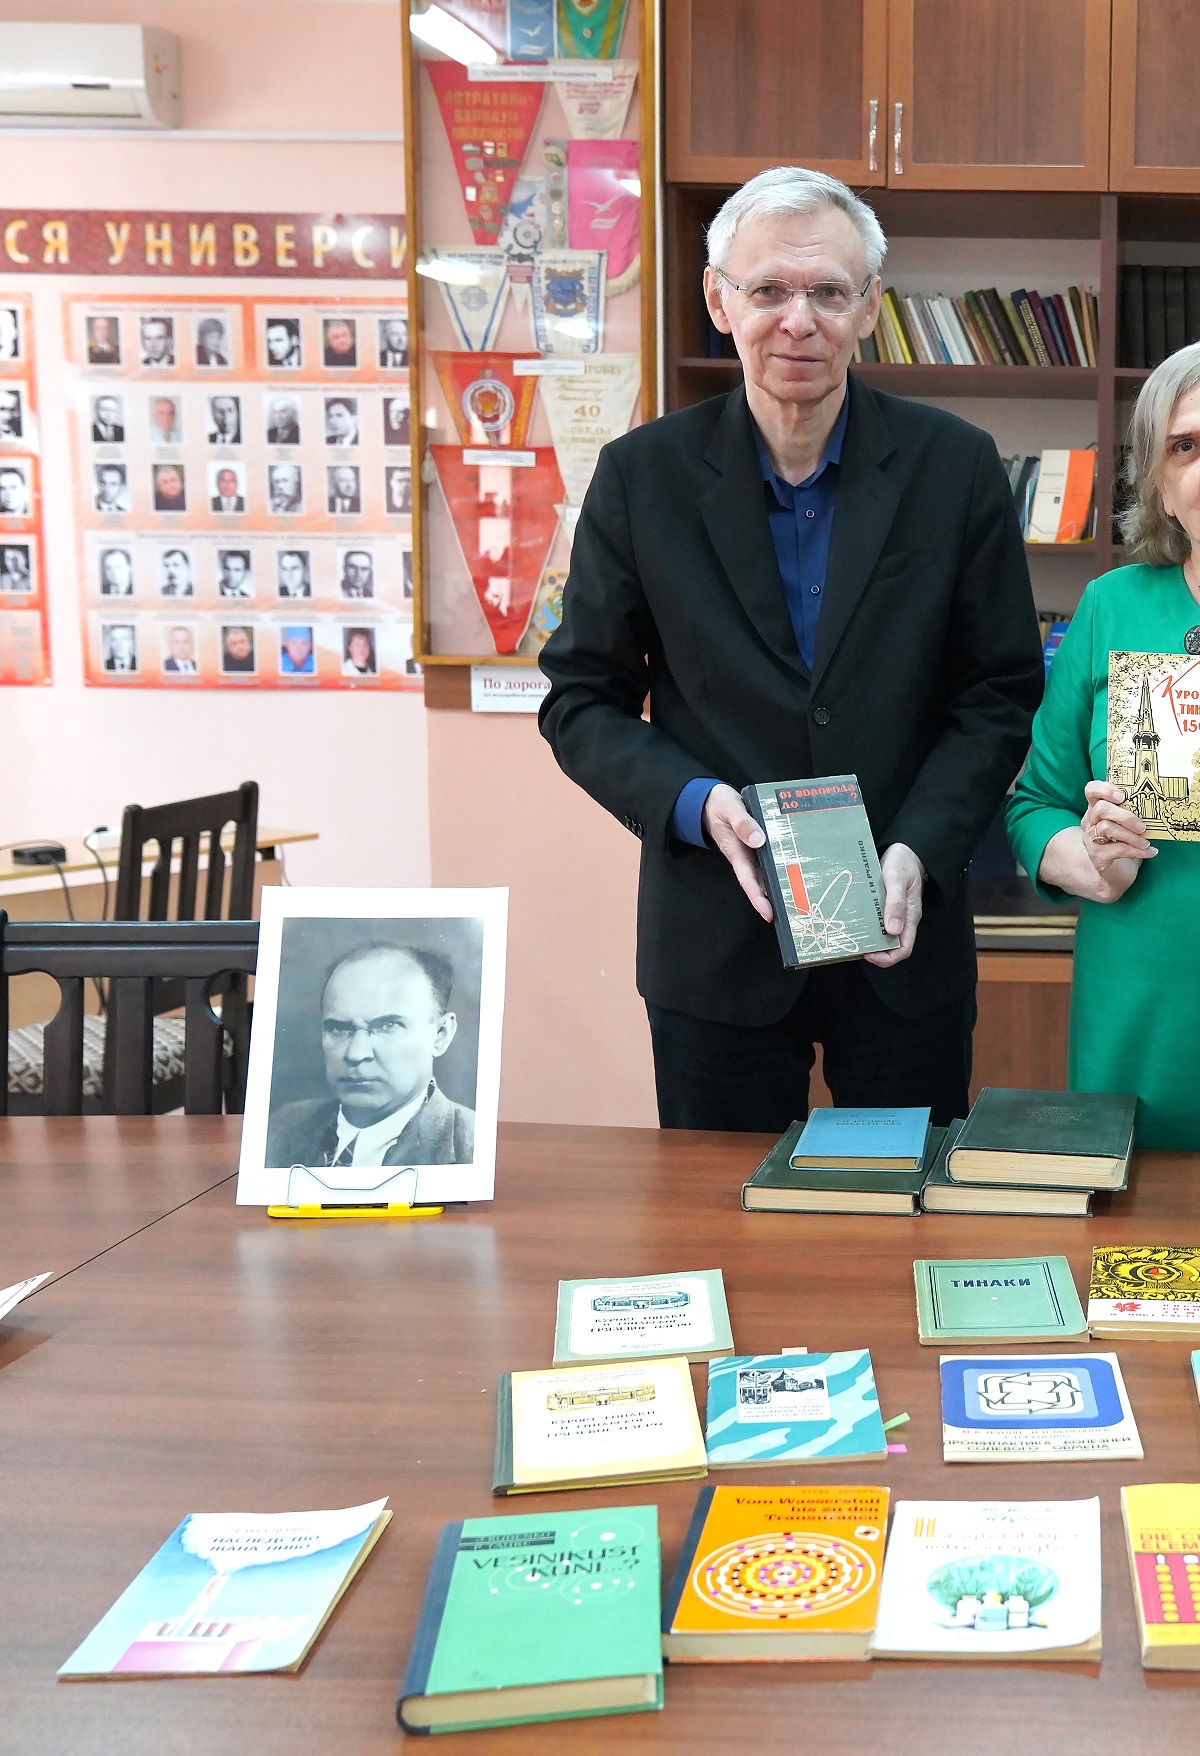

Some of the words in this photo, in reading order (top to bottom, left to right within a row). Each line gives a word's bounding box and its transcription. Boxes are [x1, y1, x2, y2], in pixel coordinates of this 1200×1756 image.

[574, 405, 601, 417] 40
[483, 678, 501, 689] По
[796, 784, 856, 798] ВОДОРОДА
[951, 1278, 1031, 1288] ТИНАКИ
[1063, 1436, 1131, 1445] БОЛЕЗНЕЙ
[736, 1496, 773, 1504] Vom
[213, 1535, 320, 1544] НАСЛЕДСТВО
[1140, 1531, 1174, 1541] DIE
[472, 1545, 643, 1570] VESINIKUST
